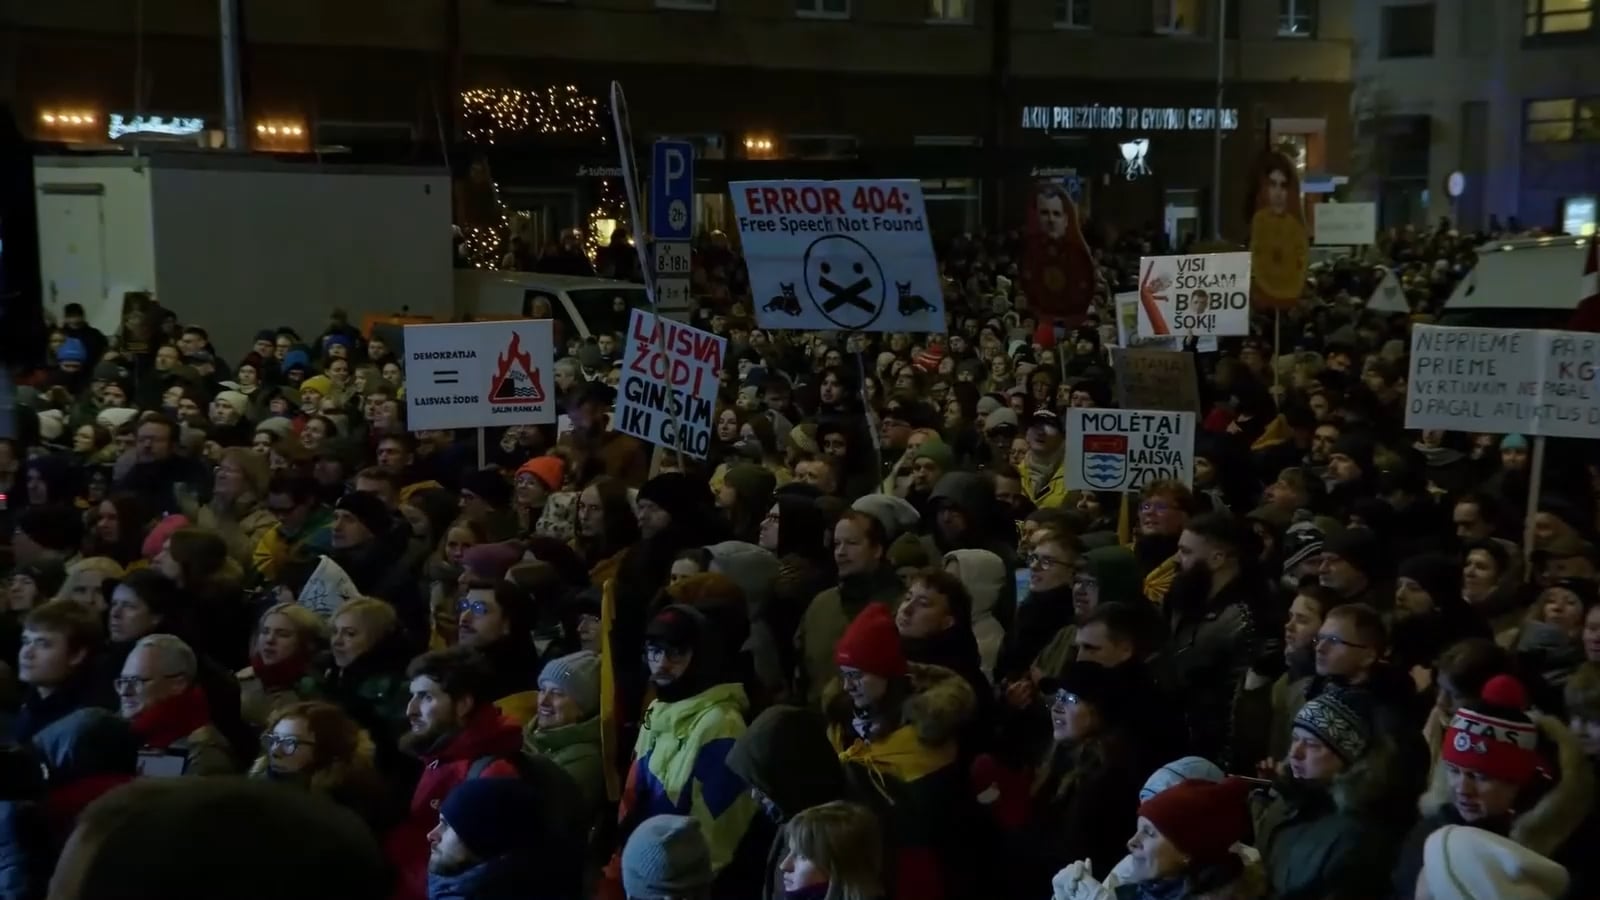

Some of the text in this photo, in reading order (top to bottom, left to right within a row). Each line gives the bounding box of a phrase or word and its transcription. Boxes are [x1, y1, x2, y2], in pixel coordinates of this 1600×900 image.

[1126, 107, 1139, 130] IR
[664, 148, 686, 196] P
[744, 186, 913, 215] ERROR 404:
[740, 216, 924, 236] Free Speech Not Found
[1177, 258, 1205, 272] VISI
[1175, 273, 1237, 290] ŠOKAM
[1175, 291, 1247, 312] BBIO
[413, 350, 477, 361] DEMOKRATIJA
[634, 314, 721, 377] LAISVĄ
[415, 396, 451, 406] LAISVAS
[625, 376, 711, 427] GINSIM
[622, 405, 709, 456] IKI GALO
[1143, 433, 1170, 450] UŽ
